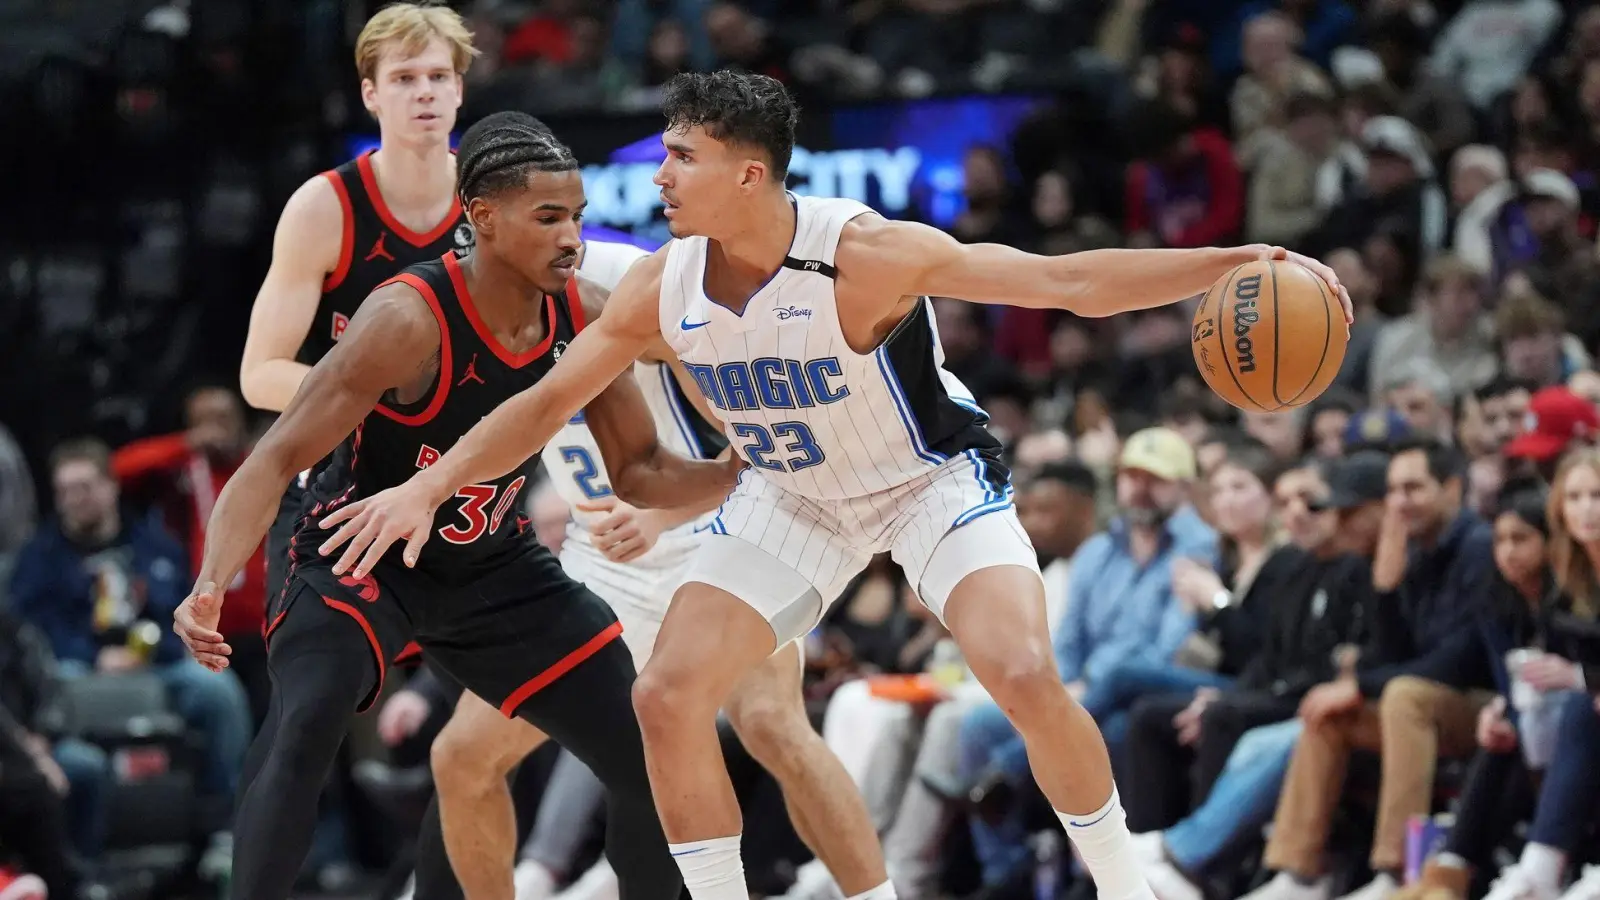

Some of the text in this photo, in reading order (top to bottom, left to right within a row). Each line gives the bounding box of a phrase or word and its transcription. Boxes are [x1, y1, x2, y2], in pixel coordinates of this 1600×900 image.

[804, 261, 821, 271] PW
[1233, 273, 1262, 374] Wilson
[731, 420, 826, 473] 23
[438, 475, 526, 545] 30
